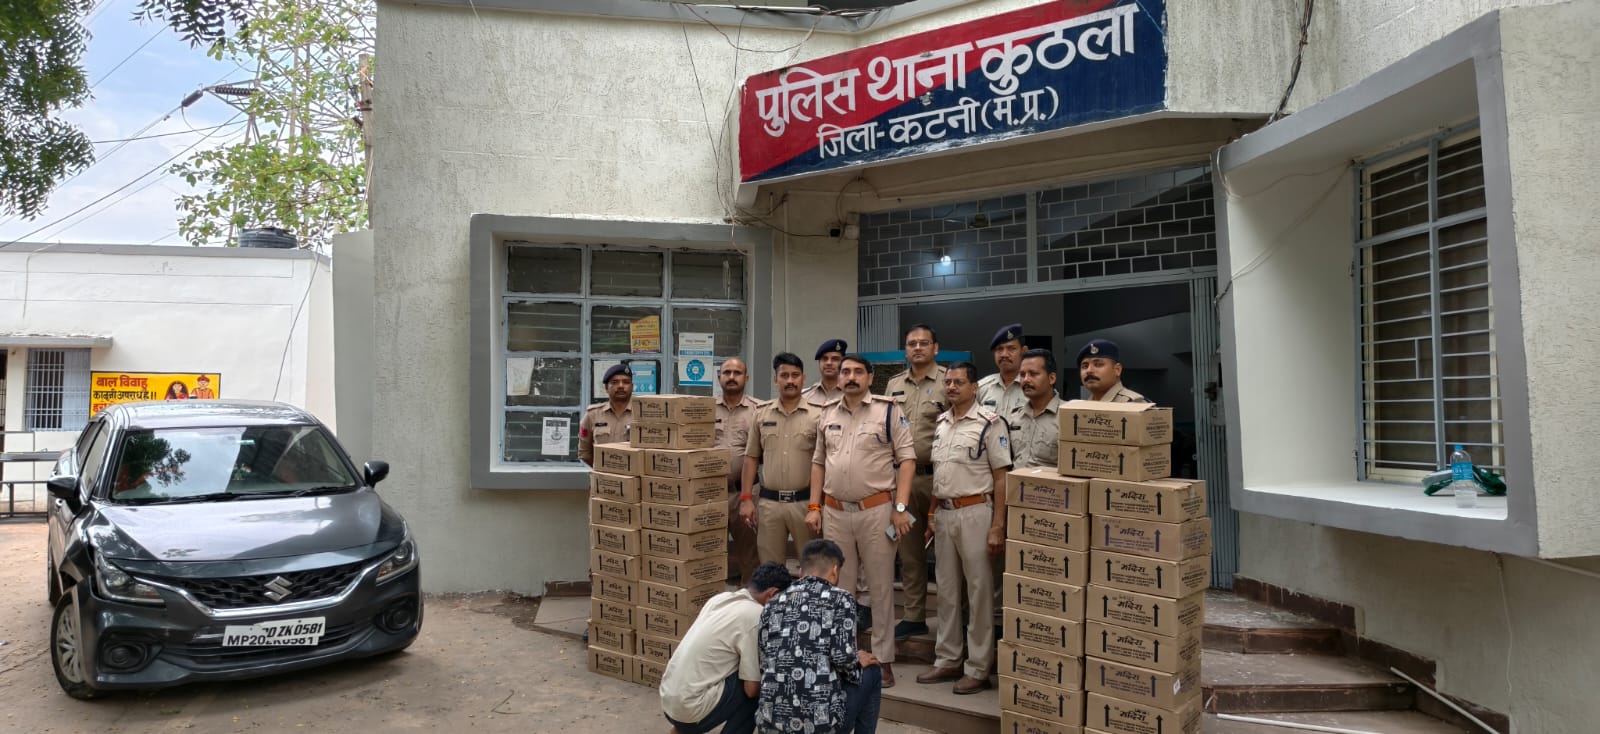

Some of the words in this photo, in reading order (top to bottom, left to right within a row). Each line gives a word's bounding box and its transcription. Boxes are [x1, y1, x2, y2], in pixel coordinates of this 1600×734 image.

[755, 67, 861, 137] पुलिस
[867, 41, 974, 102] थाना
[974, 3, 1141, 96] कुठला
[96, 377, 118, 387] बाल
[119, 375, 148, 390] विवाह
[1088, 416, 1113, 427] मदिरा
[1085, 451, 1109, 461] मदिरा
[1120, 491, 1146, 501] मदिरा
[1034, 517, 1056, 529] मदिरा
[1119, 526, 1145, 537] मदिरा
[1032, 552, 1055, 563] मदिरा
[1120, 563, 1145, 574] मदिरा
[1029, 586, 1052, 597] मदिरा
[1117, 600, 1143, 611] मदिरा
[277, 624, 294, 637] ZK
[294, 622, 323, 635] 0581
[1029, 622, 1052, 632] मदिरा
[1116, 635, 1143, 646] मदिरा
[1025, 656, 1048, 667] मदिरा
[1115, 670, 1140, 681] मदिरा
[1026, 689, 1050, 701] मदिरा
[1119, 709, 1146, 722] मदिरा
